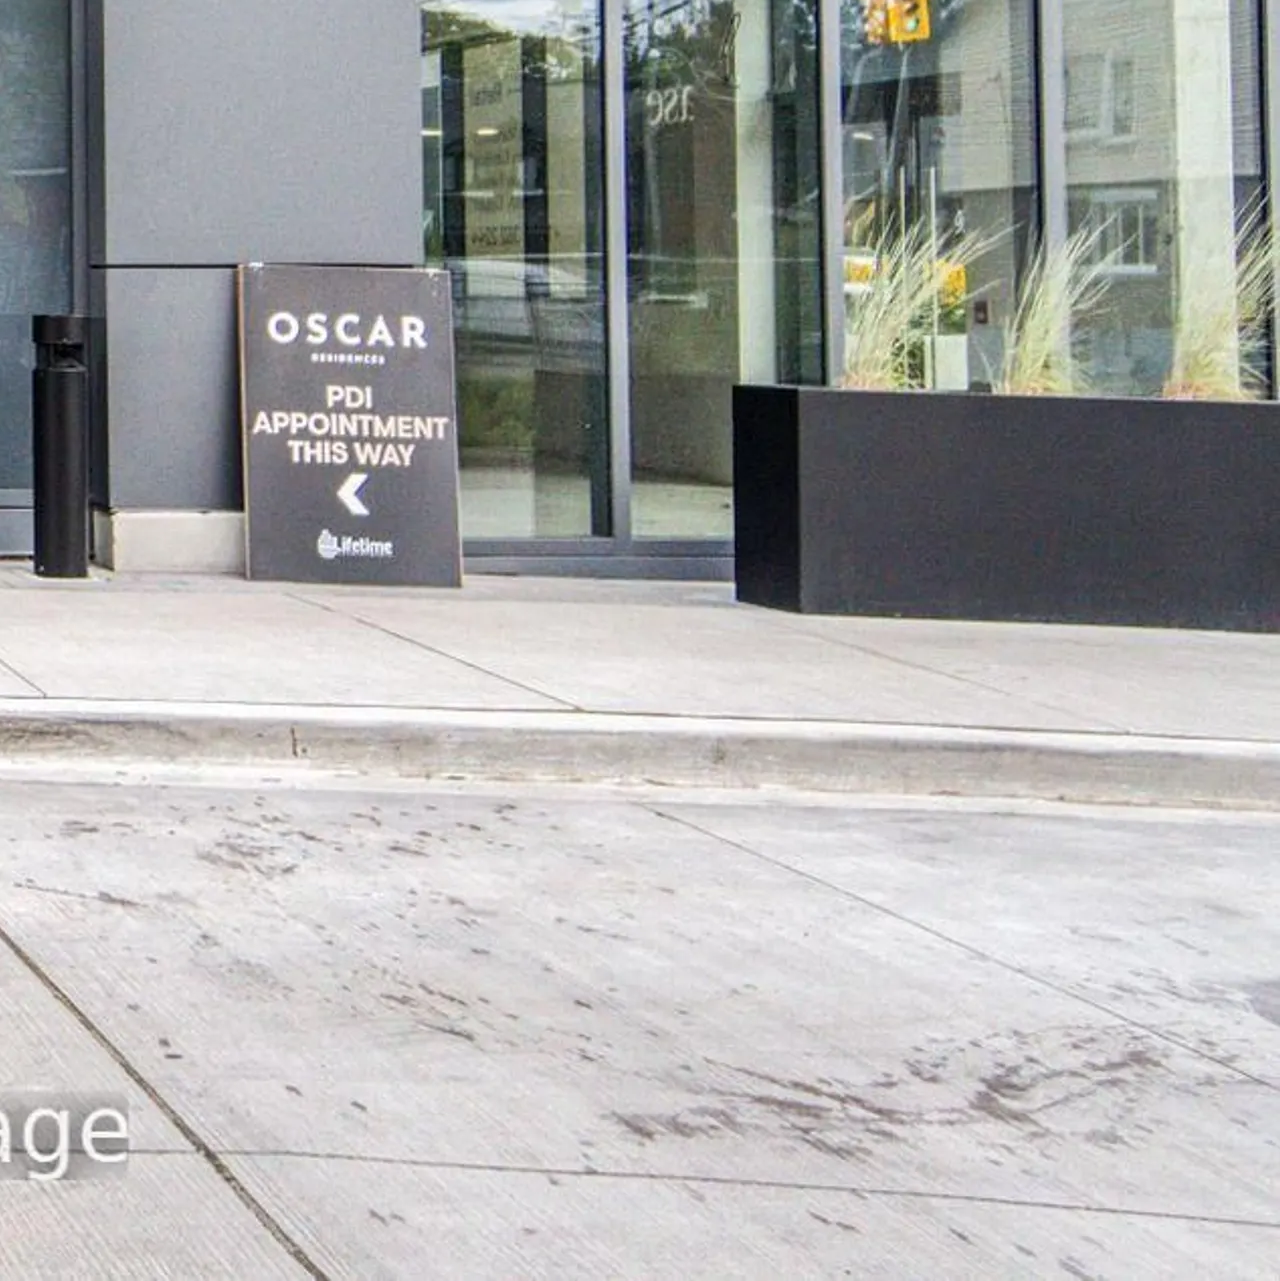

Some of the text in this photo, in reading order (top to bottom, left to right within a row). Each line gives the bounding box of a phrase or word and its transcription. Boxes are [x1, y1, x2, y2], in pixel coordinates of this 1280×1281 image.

[267, 312, 428, 349] OSCAR
[326, 385, 373, 409] PDI
[252, 411, 450, 440] APPOINTMENT
[287, 440, 416, 468] THIS WAY
[332, 535, 393, 556] Lifetime
